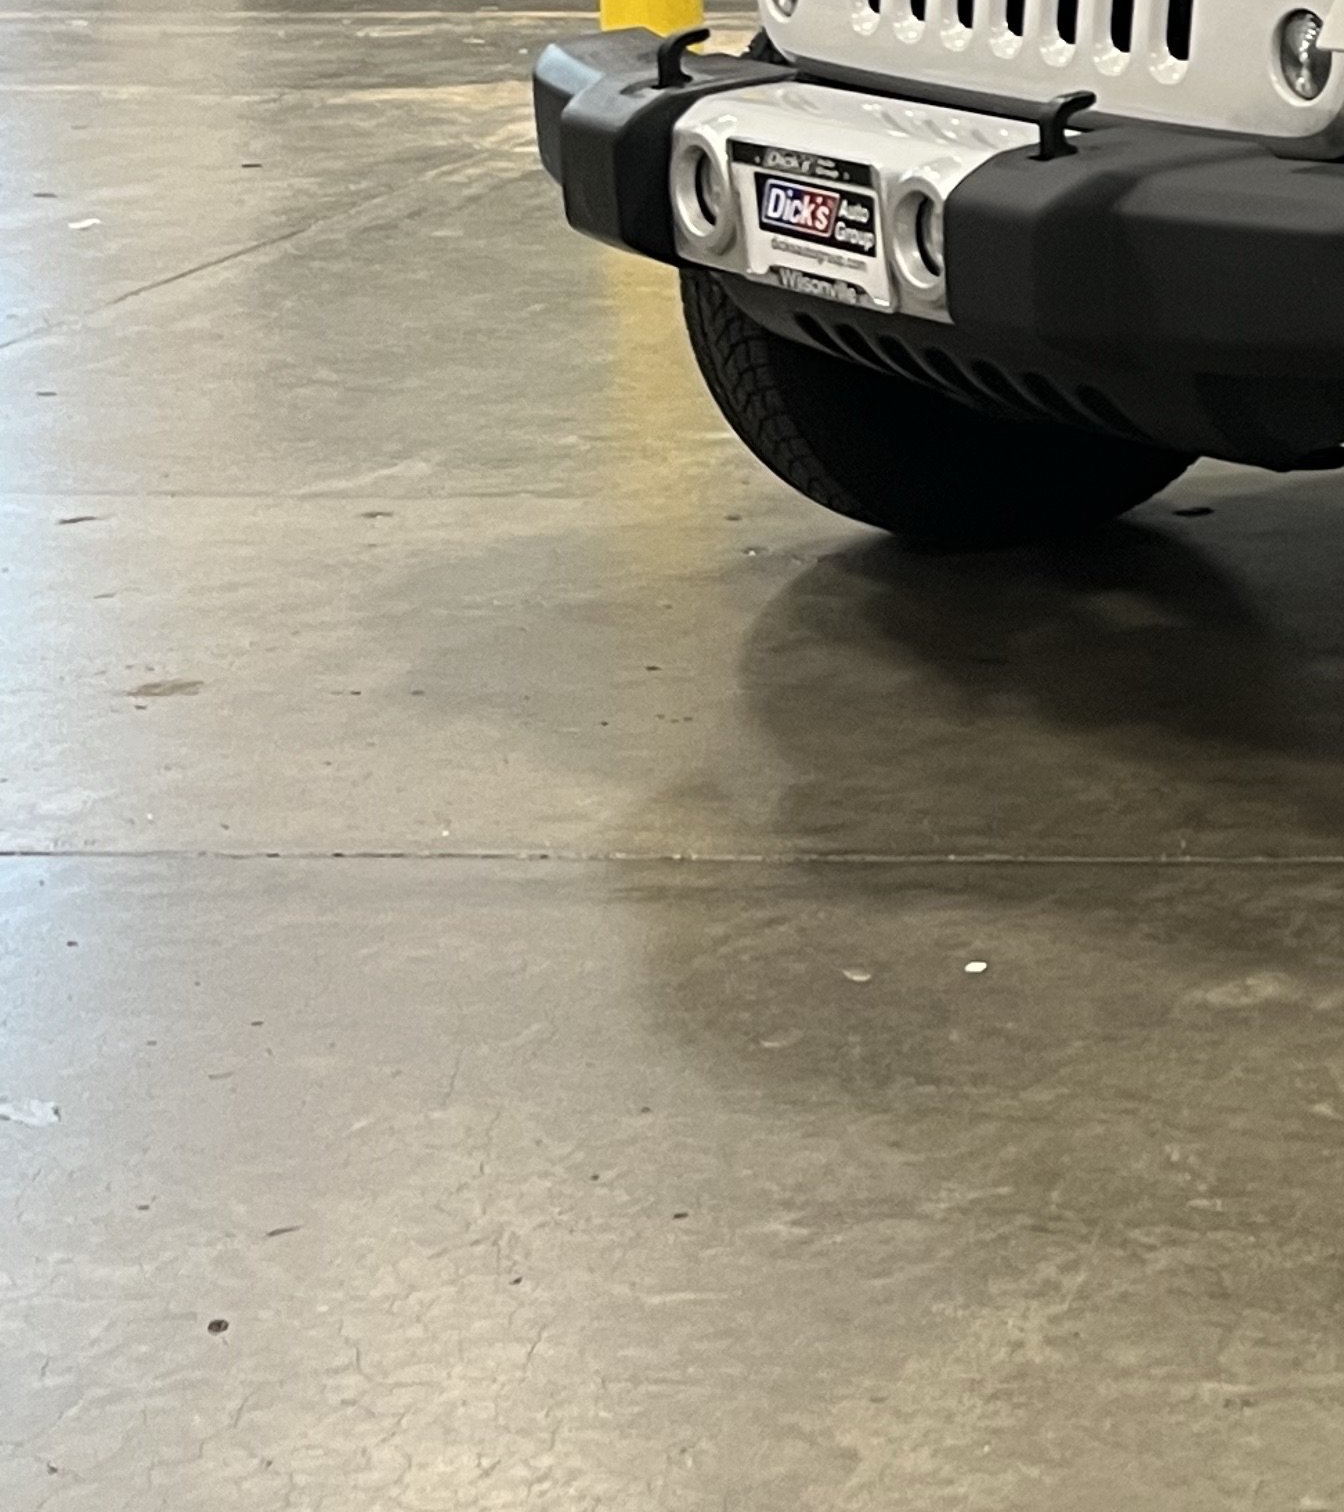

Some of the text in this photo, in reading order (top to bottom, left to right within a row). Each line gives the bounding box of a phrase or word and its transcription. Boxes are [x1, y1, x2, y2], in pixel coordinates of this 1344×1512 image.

[767, 188, 830, 230] Dick's
[838, 199, 870, 224] Auto
[834, 221, 875, 252] Group
